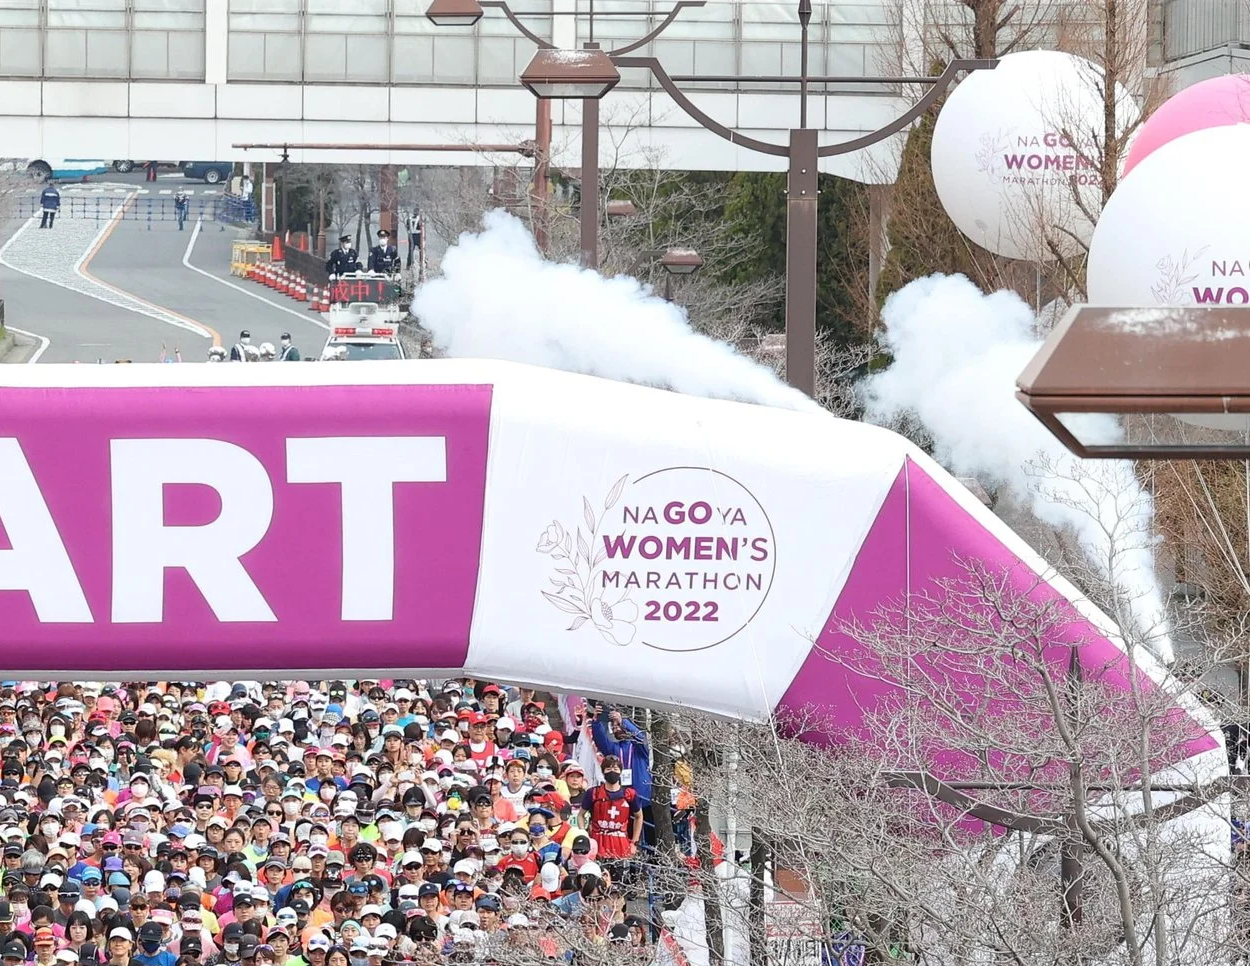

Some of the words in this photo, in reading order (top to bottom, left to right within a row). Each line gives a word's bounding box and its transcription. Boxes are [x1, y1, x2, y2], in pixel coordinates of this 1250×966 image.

[622, 500, 748, 526] NAGOYA
[602, 535, 769, 562] WOMEN'S
[601, 570, 762, 591] MARATHON
[644, 600, 719, 622] 2022
